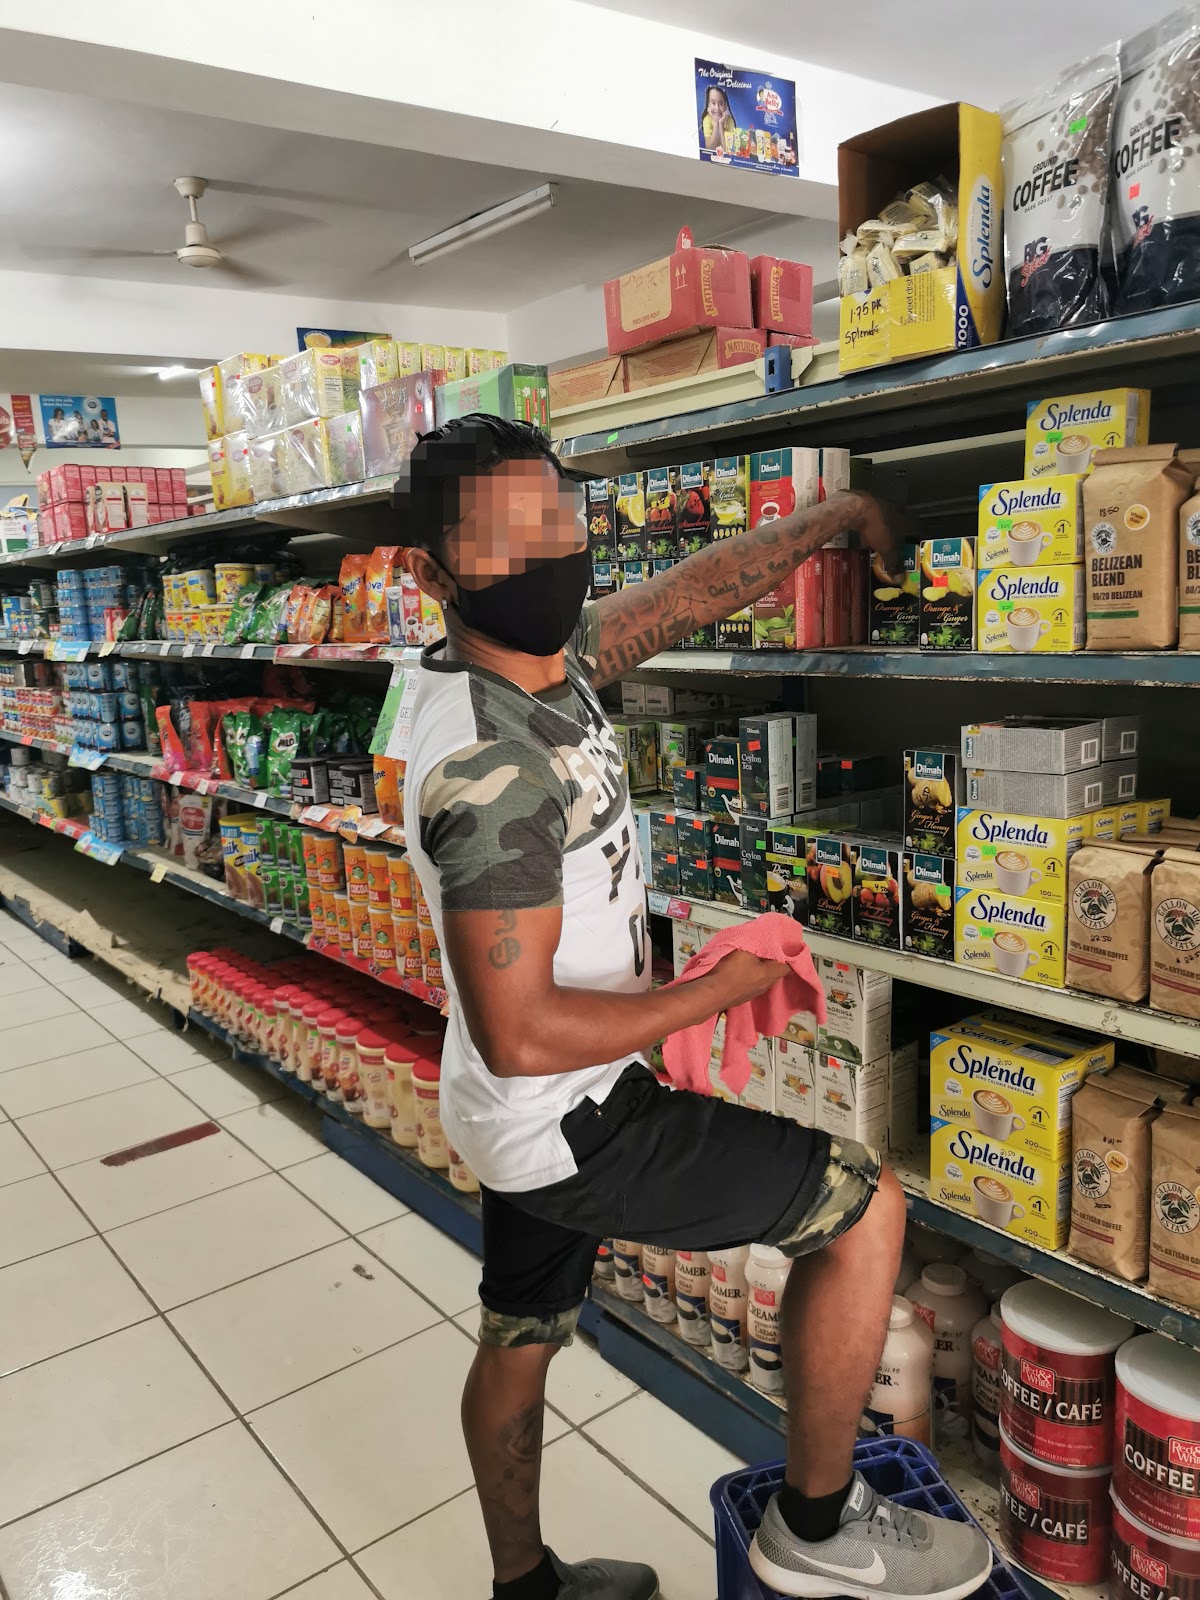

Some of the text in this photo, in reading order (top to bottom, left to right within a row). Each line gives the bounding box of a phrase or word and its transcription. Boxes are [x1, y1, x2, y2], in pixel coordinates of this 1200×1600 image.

[698, 68, 733, 81] The Original
[726, 79, 752, 89] Delicious
[1115, 118, 1182, 179] COFFEE
[1032, 156, 1058, 174] GROUND
[1012, 159, 1079, 212] COFFEE
[1025, 204, 1036, 213] DARK
[973, 185, 993, 289] Splenda
[1024, 236, 1050, 263] BIG
[702, 261, 714, 312] NATURA'S
[771, 267, 781, 318] NATURA'S
[958, 304, 969, 347] 1000
[726, 339, 761, 353] NATURA'S
[1040, 400, 1112, 430] Splenda
[1106, 435, 1114, 445] #1
[717, 468, 737, 477] Dilmah
[761, 463, 780, 473] Dilmah
[682, 474, 702, 483] Dilmah
[991, 488, 1061, 516] Splenda
[620, 524, 641, 535] Lemon
[1057, 523, 1065, 533] #1
[933, 552, 960, 562] Dilmah
[1091, 554, 1143, 571] BELIZEAN
[1091, 572, 1126, 587] BLEND
[708, 578, 740, 600] Only
[990, 574, 1059, 601] Splenda
[1110, 590, 1143, 600] BELIZEAN
[875, 603, 904, 617] Orange
[923, 603, 951, 619] Orange
[1055, 612, 1062, 622] #1
[943, 613, 968, 624] Ginger
[278, 738, 295, 748] MILO
[709, 753, 735, 765] Dilmah
[741, 754, 762, 765] Ceylon
[742, 762, 752, 770] Tea
[916, 763, 942, 775] Dilmah
[909, 809, 933, 824] Ginger
[678, 830, 691, 838] Ceylon
[924, 821, 950, 836] Honey
[973, 814, 1048, 843] Splenda
[224, 841, 239, 855] uik
[714, 834, 739, 848] Dilmah
[244, 848, 260, 863] uik
[774, 843, 795, 854] Dilmah
[818, 850, 840, 861] Dilmah
[742, 851, 762, 861] Ceylon
[742, 859, 752, 867] Tea
[771, 864, 790, 875] Pure
[862, 859, 886, 871] Dilmah
[1047, 862, 1056, 872] #1
[681, 869, 694, 877] Ceylon
[916, 866, 942, 879] Dilmah
[966, 871, 993, 882] Splenda
[781, 875, 801, 888] Green
[350, 884, 369, 894] COCOA
[1075, 881, 1114, 905] GALLON JUG
[817, 898, 846, 911] Peach
[970, 894, 1046, 927] Splenda
[909, 910, 933, 926] Ginger
[1157, 900, 1200, 925] GALLON JUG
[1079, 914, 1108, 929] ESTATE
[924, 923, 950, 939] Honey
[1163, 934, 1195, 950] ESTATE
[375, 949, 394, 959] COCOA
[963, 949, 991, 961] Splenda
[1044, 945, 1053, 956] #1
[1083, 944, 1129, 961] ARTISAN COFFEE
[1037, 972, 1049, 980] 100
[1168, 965, 1195, 978] ARTISAN
[826, 975, 844, 984] MIRACLE
[827, 1006, 853, 1018] MORINGA
[949, 1044, 1036, 1091] Splenda
[987, 1079, 1035, 1097] CALORIE SWEETENER
[823, 1107, 847, 1119] MORINGA
[939, 1104, 971, 1118] Splenda
[1032, 1111, 1042, 1123] #1
[1024, 1138, 1039, 1148] 200
[949, 1130, 1035, 1181] Splenda
[1096, 1159, 1108, 1176] JUG
[987, 1165, 1035, 1187] CALORIE SWEETENER
[939, 1187, 971, 1202] Splenda
[1076, 1183, 1102, 1199] ESTATE
[1157, 1181, 1198, 1210] GALLON JUG
[1032, 1200, 1042, 1212] #1
[1079, 1213, 1122, 1232] ARTISAN COFFEE
[1160, 1216, 1192, 1234] ESTATE
[1024, 1226, 1039, 1238] 200
[1164, 1248, 1191, 1263] ARTISAN
[1022, 1361, 1051, 1384] Red &
[1026, 1373, 1052, 1390] White
[1001, 1368, 1040, 1411] OFFEE
[1043, 1398, 1052, 1415] /
[1055, 1398, 1102, 1421] CAFÉ
[1172, 1440, 1192, 1455] Red
[1125, 1443, 1195, 1492] COFFEE
[1012, 1473, 1037, 1499] Red &
[1015, 1484, 1038, 1502] White
[1154, 1505, 1172, 1518] makers
[1030, 1512, 1088, 1540] / CAFÉ
[1158, 1521, 1170, 1532] PESO
[1170, 1526, 1184, 1535] NETO
[1132, 1549, 1163, 1578] Red &
[1137, 1562, 1163, 1581] White
